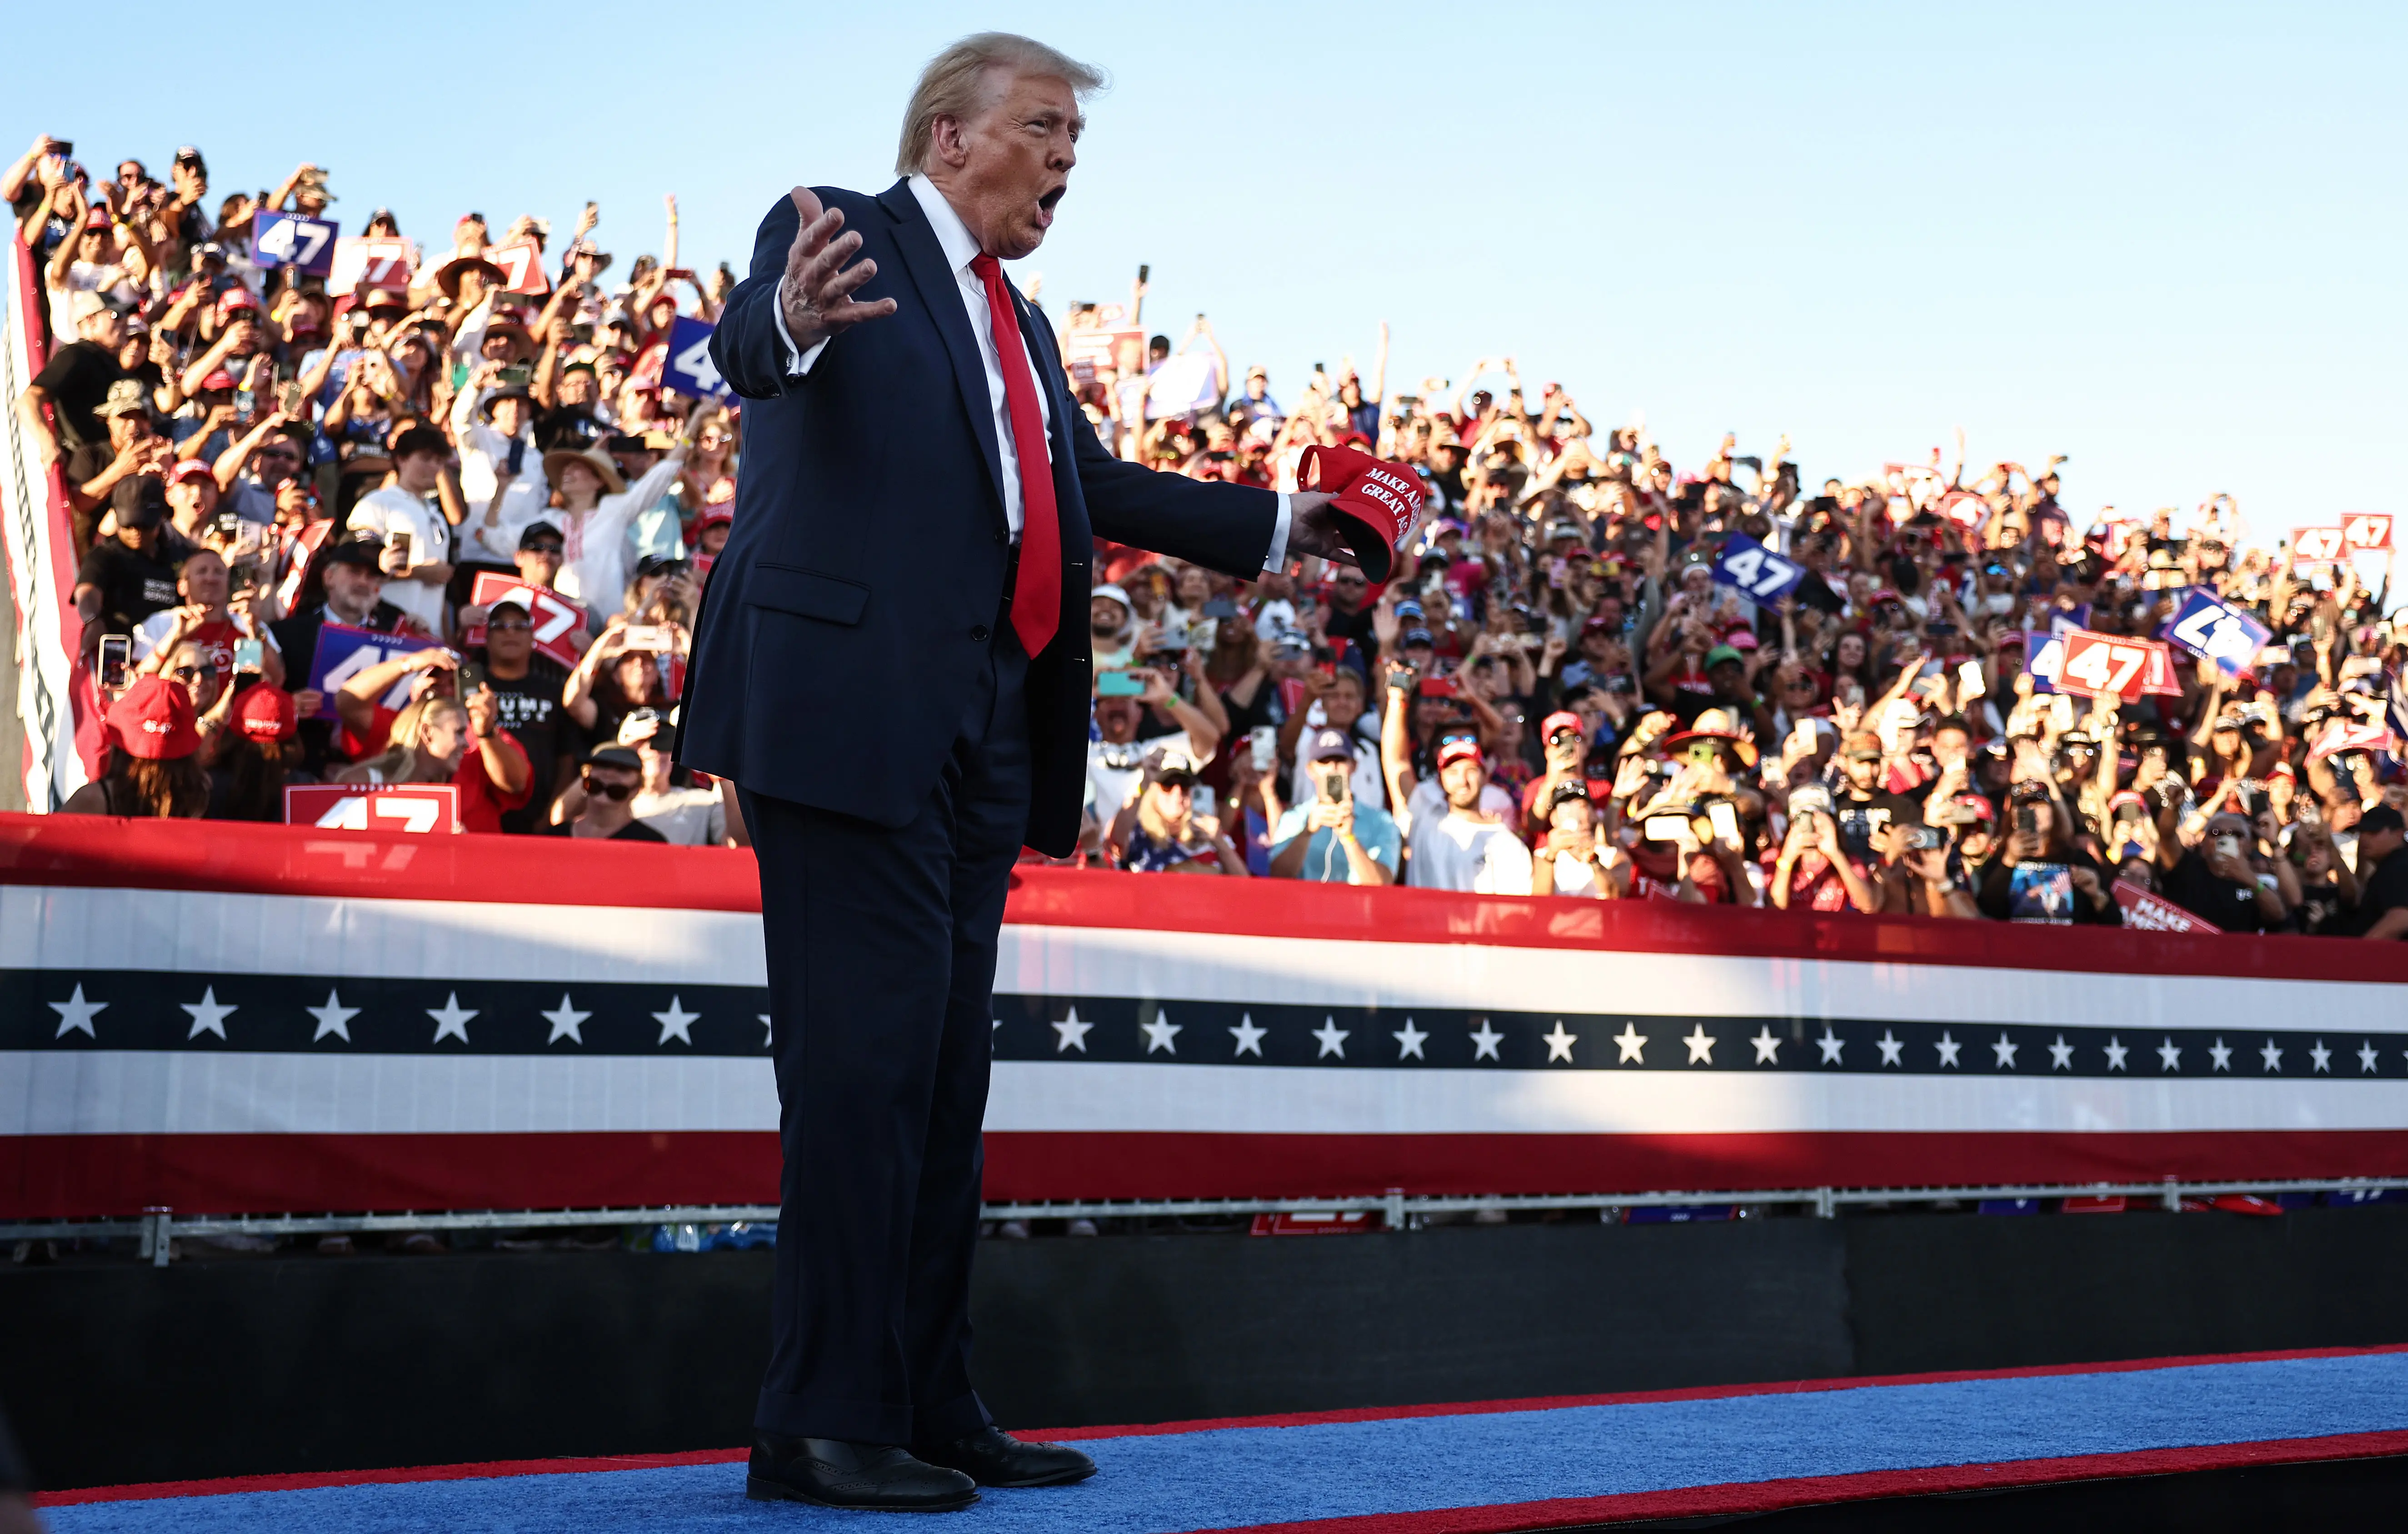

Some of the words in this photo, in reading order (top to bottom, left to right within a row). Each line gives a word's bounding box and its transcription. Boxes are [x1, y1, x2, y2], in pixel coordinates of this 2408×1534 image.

[258, 218, 331, 265] 47
[485, 246, 531, 289] 7
[674, 333, 733, 397] 4
[1361, 483, 1405, 516] GREAT
[1365, 468, 1410, 494] MAKE
[2295, 528, 2343, 559] 47
[2345, 515, 2389, 547] 47
[1724, 548, 1795, 597] 47
[2173, 605, 2253, 658] 47
[2067, 642, 2146, 697] 47
[499, 696, 553, 712] UMP
[2136, 897, 2193, 933] MAKE
